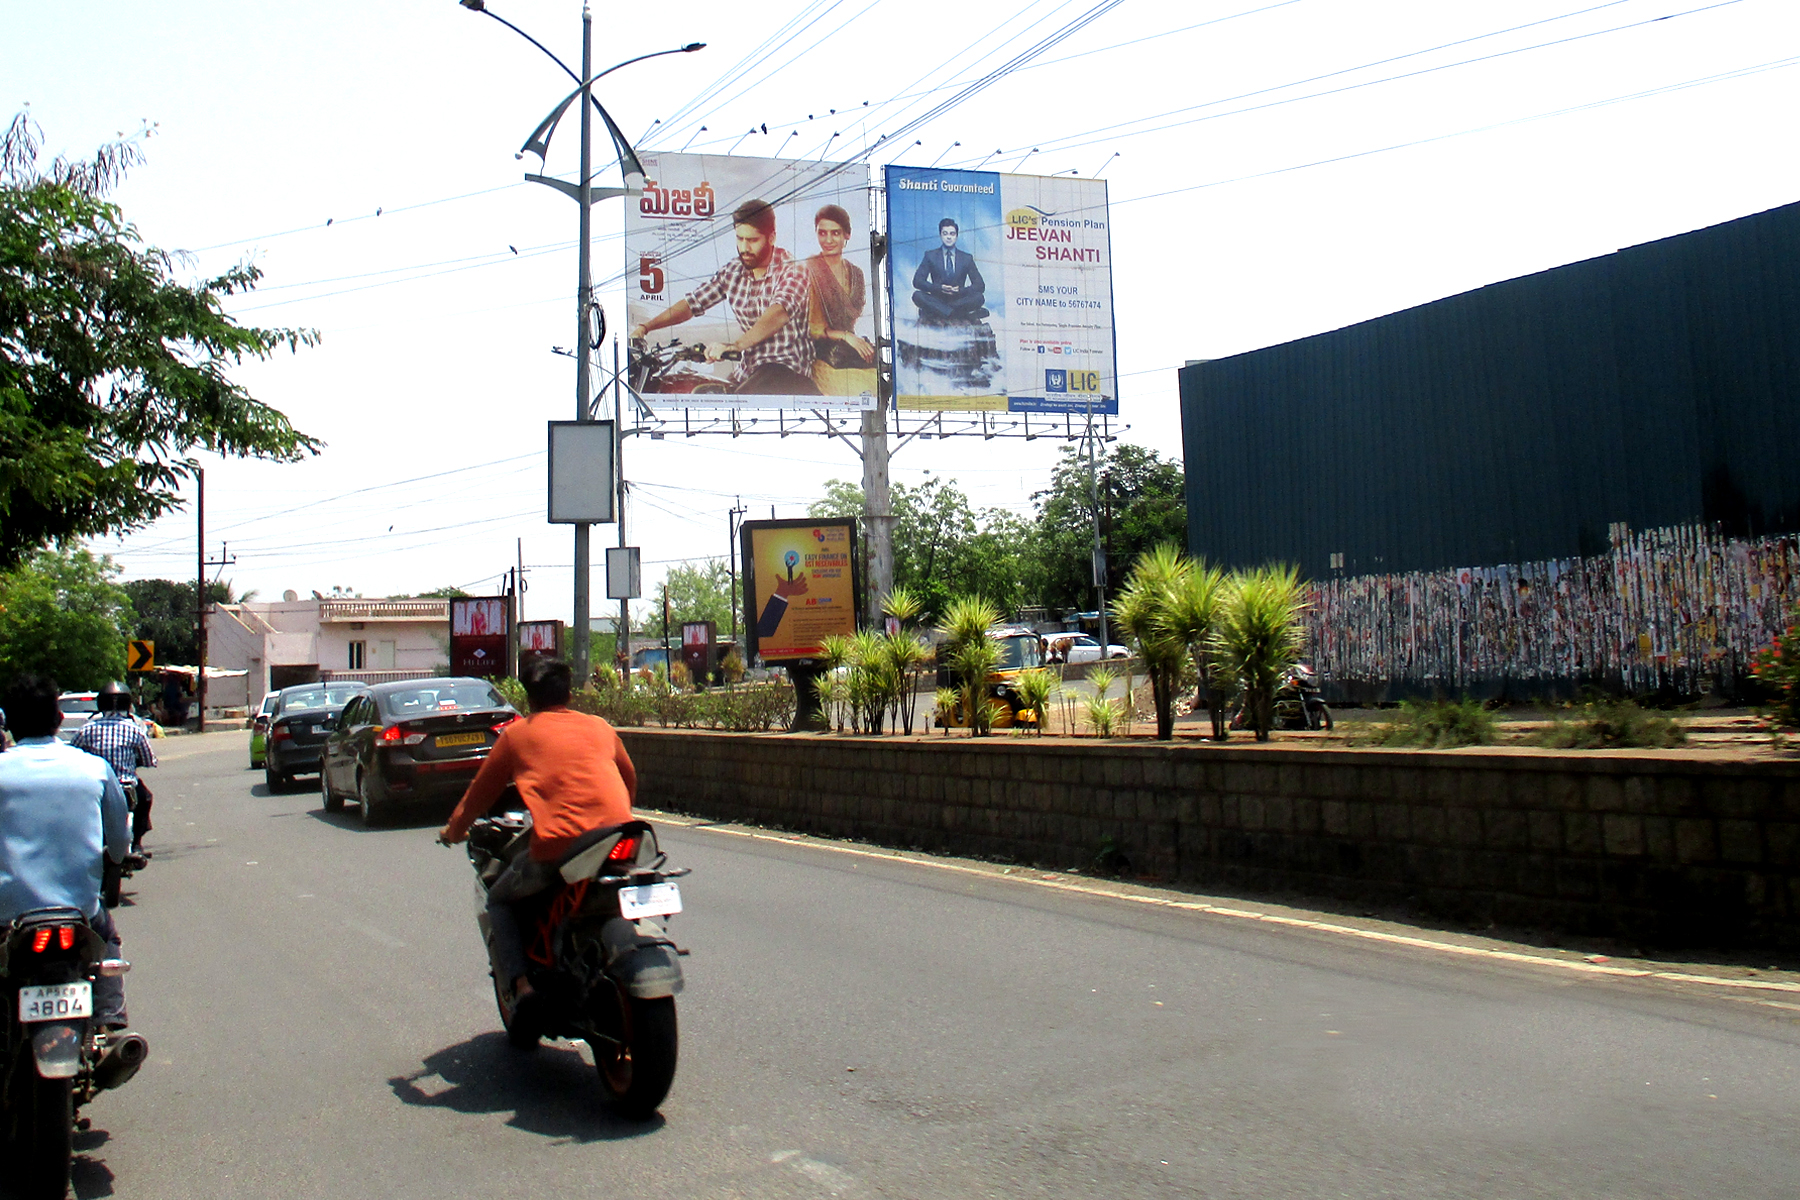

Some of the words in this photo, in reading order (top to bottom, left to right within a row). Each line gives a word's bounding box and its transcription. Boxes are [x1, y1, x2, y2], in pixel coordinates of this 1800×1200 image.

[899, 178, 938, 191] Shanti
[941, 180, 994, 194] Guaranteed
[640, 181, 714, 216] మజిలీ
[1012, 215, 1037, 225] LIC's
[1041, 216, 1081, 228] Pension
[1084, 219, 1105, 229] Plan
[1006, 226, 1071, 243] JEEVAN
[1035, 245, 1100, 262] SHANTI
[640, 257, 664, 294] 5
[1038, 285, 1055, 294] SMS
[1057, 286, 1078, 295] YOUR
[1016, 297, 1034, 306] CITY
[1035, 298, 1057, 307] NAME
[1059, 299, 1067, 308] to
[1068, 300, 1101, 309] 56767474
[1070, 372, 1097, 391] LIC
